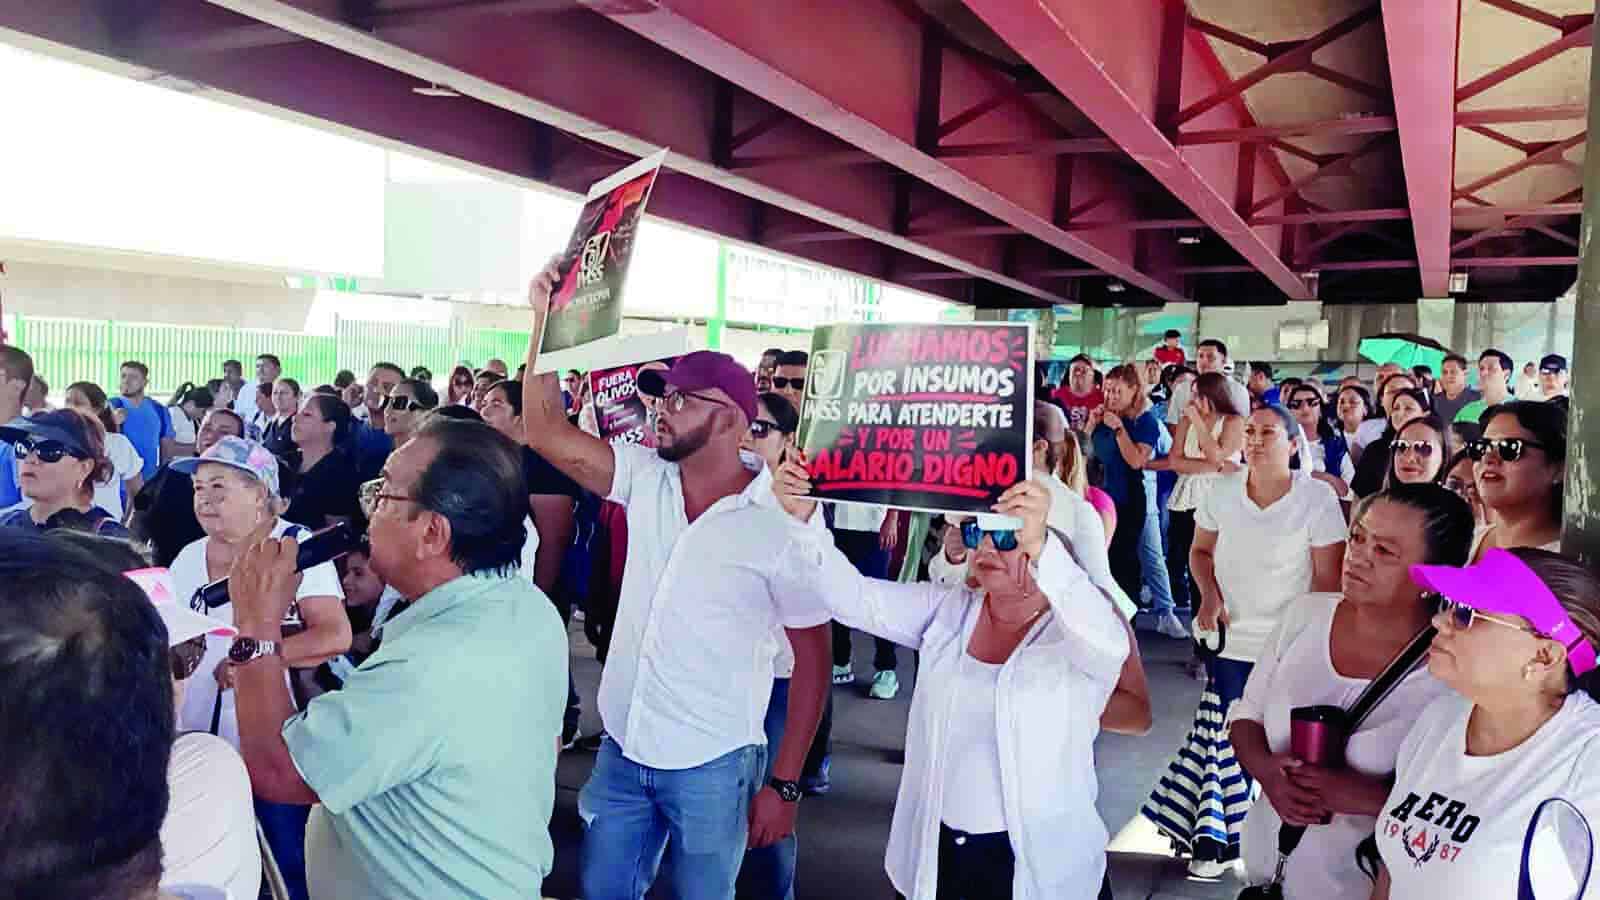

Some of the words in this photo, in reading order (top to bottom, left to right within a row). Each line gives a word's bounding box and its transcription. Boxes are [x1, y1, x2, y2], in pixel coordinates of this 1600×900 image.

[596, 379, 636, 406] OLIVOS
[598, 369, 632, 391] FUERA
[852, 368, 896, 397] POR
[902, 364, 1015, 397] INSUMOS
[848, 401, 892, 425] PARA
[898, 402, 1013, 428] ATENDERTE
[857, 427, 871, 450] Y
[874, 427, 915, 450] POR
[922, 427, 950, 450] UN
[922, 452, 1018, 488] DIGNO
[1390, 791, 1481, 843] AERO
[1383, 819, 1400, 837] 19
[1439, 843, 1462, 862] 87
